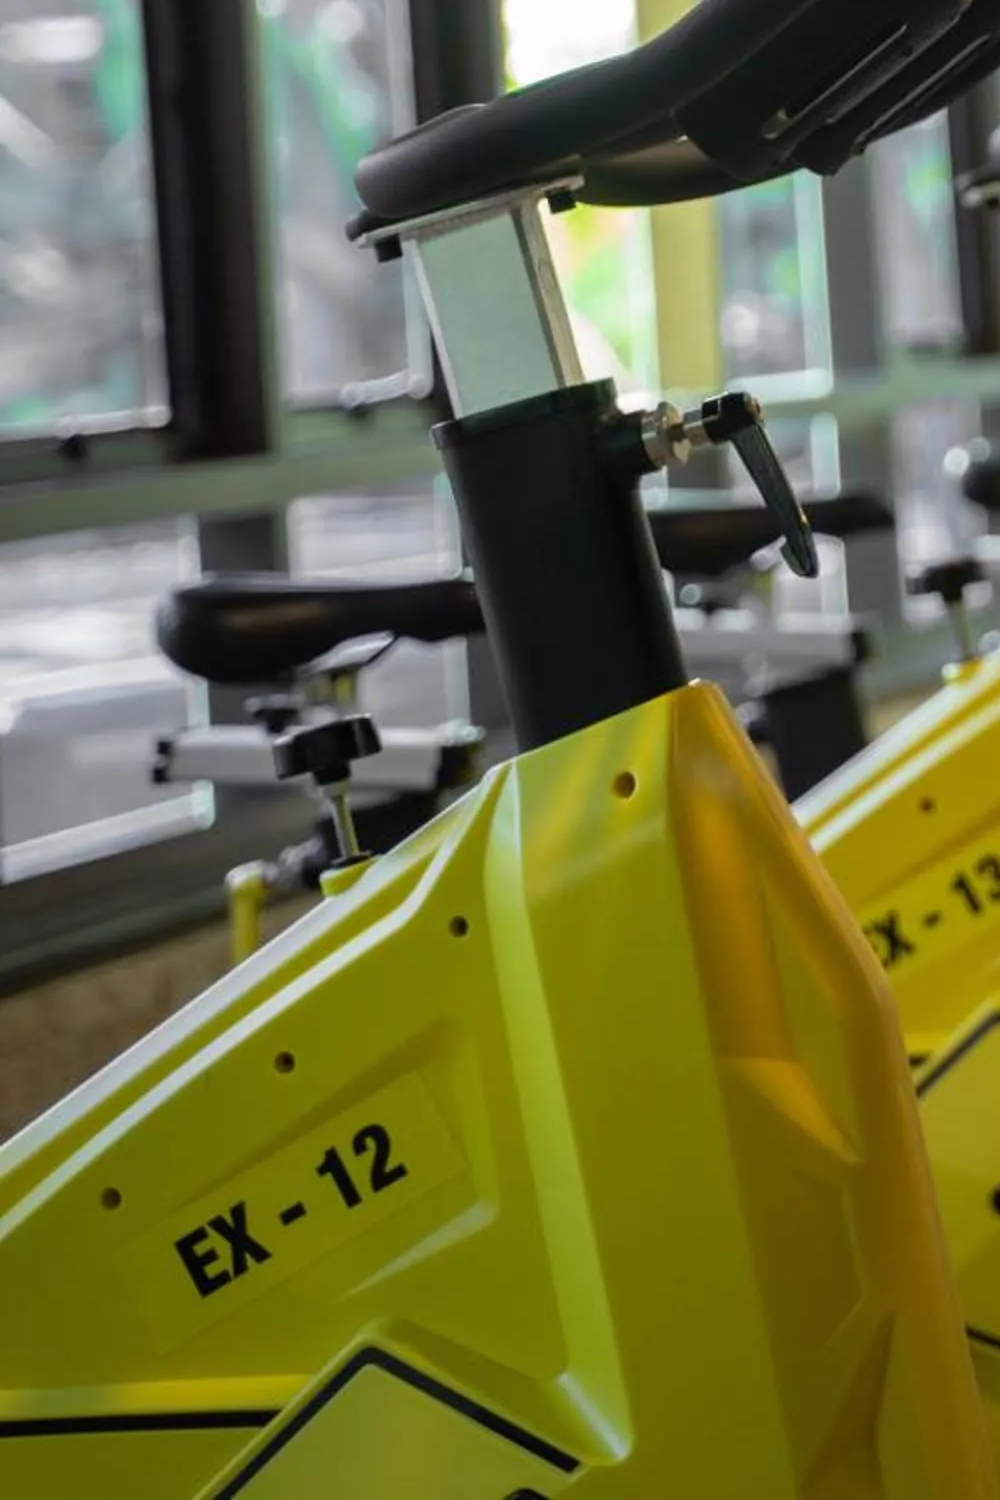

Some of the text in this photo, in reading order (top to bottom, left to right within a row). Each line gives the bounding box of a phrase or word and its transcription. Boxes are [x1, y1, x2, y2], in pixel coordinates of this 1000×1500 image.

[863, 910, 917, 971] X
[174, 1200, 273, 1299] EX
[315, 1123, 409, 1209] 12
